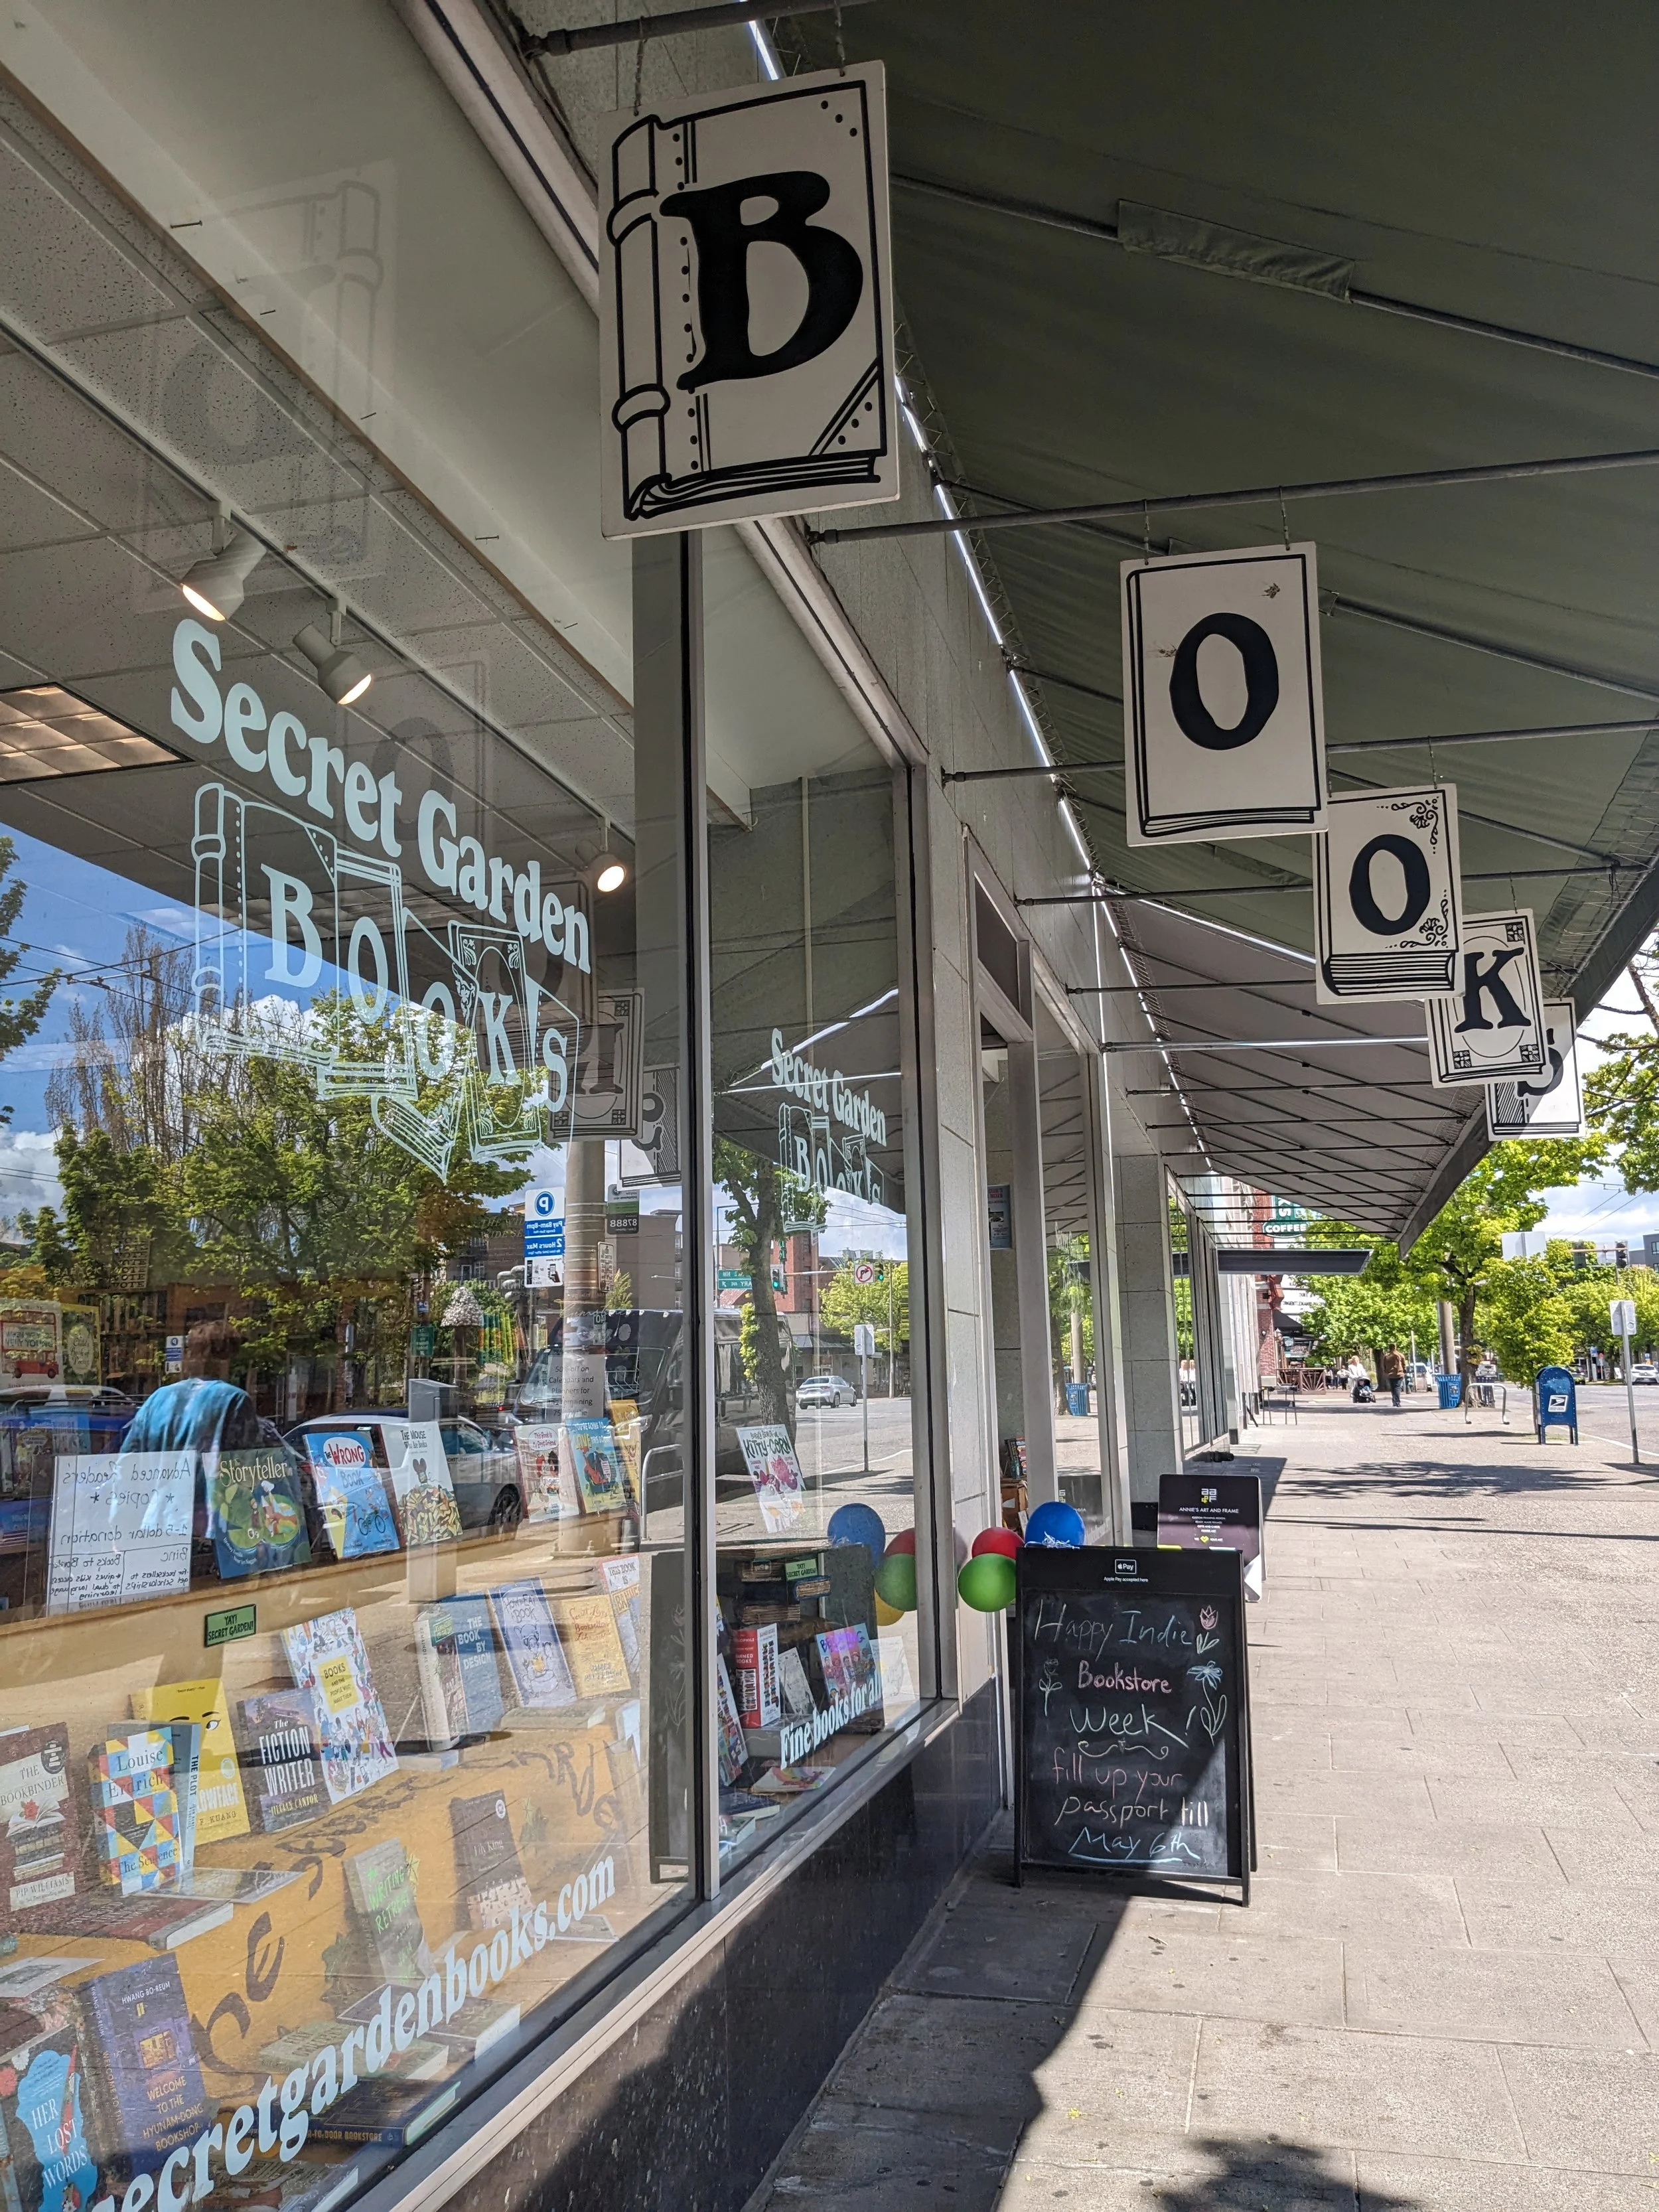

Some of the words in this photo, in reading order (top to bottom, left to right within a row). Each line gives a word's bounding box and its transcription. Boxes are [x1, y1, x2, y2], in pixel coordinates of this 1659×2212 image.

[660, 171, 863, 391] B
[1169, 613, 1279, 750] O
[171, 619, 402, 857] Secret
[419, 790, 590, 973] Garden
[1349, 834, 1430, 935] O
[1455, 947, 1532, 1033] K
[772, 1028, 828, 1112] Secret
[832, 1070, 887, 1147] Garden
[1265, 1223, 1307, 1232] COFFEE
[400, 1430, 409, 1440] THE
[410, 1430, 426, 1439] MOUSE
[328, 1443, 364, 1465] WRONG
[220, 1455, 287, 1493] Storyteller
[340, 1471, 364, 1488] BOOK
[608, 1566, 620, 1576] THIS
[621, 1562, 636, 1573] BOOK
[622, 1576, 628, 1585] IS
[787, 1570, 800, 1578] SECRET
[224, 1615, 237, 1625] YAY!
[467, 1616, 482, 1629] THE
[513, 1607, 537, 1624] BOOK
[208, 1627, 228, 1641] SECRET
[457, 1629, 480, 1645] BOOK
[1035, 1599, 1114, 1661] Happy
[1119, 1610, 1192, 1647] Indie
[476, 1641, 485, 1653] BY
[324, 1663, 346, 1679] BOOKS
[463, 1652, 492, 1670] DESIGN
[1078, 1660, 1172, 1693] Bookstore
[780, 1722, 812, 1771] Fine
[813, 1694, 849, 1750] books
[851, 1681, 867, 1719] for
[869, 1670, 883, 1706] all
[259, 1726, 311, 1765] FICTION
[117, 1748, 163, 1772] Louise
[190, 1755, 199, 1773] THE
[20, 1765, 40, 1780] THE
[264, 1759, 315, 1797] WRITER
[1052, 1747, 1082, 1784] fill
[1096, 1768, 1127, 1799] up
[1137, 1770, 1183, 1806] your
[1, 1775, 64, 1806] BOOKBINDER
[108, 1773, 163, 1799] Erdrich
[295, 1793, 319, 1808] CANTOR
[209, 1810, 237, 1823] KUANG
[1068, 1826, 1141, 1860] May
[1149, 1832, 1201, 1860] 6th
[16, 1885, 29, 1898] PIP
[31, 1877, 70, 1893] WILLIAMS
[368, 1866, 405, 1911] WRITING
[121, 1990, 145, 2005] HWANG
[145, 1981, 171, 1999] BO-REUM
[147, 2075, 187, 2101] WELCOME
[31, 2098, 58, 2130] HER
[157, 2101, 169, 2114] TO
[170, 2095, 185, 2108] THE
[143, 2102, 203, 2139] HYUNAM-DONG
[48, 2118, 78, 2154] LOST
[155, 2122, 201, 2152] BOOKSHOP
[344, 2131, 382, 2142] BOOKSTORE
[42, 2145, 88, 2189] WORDS
